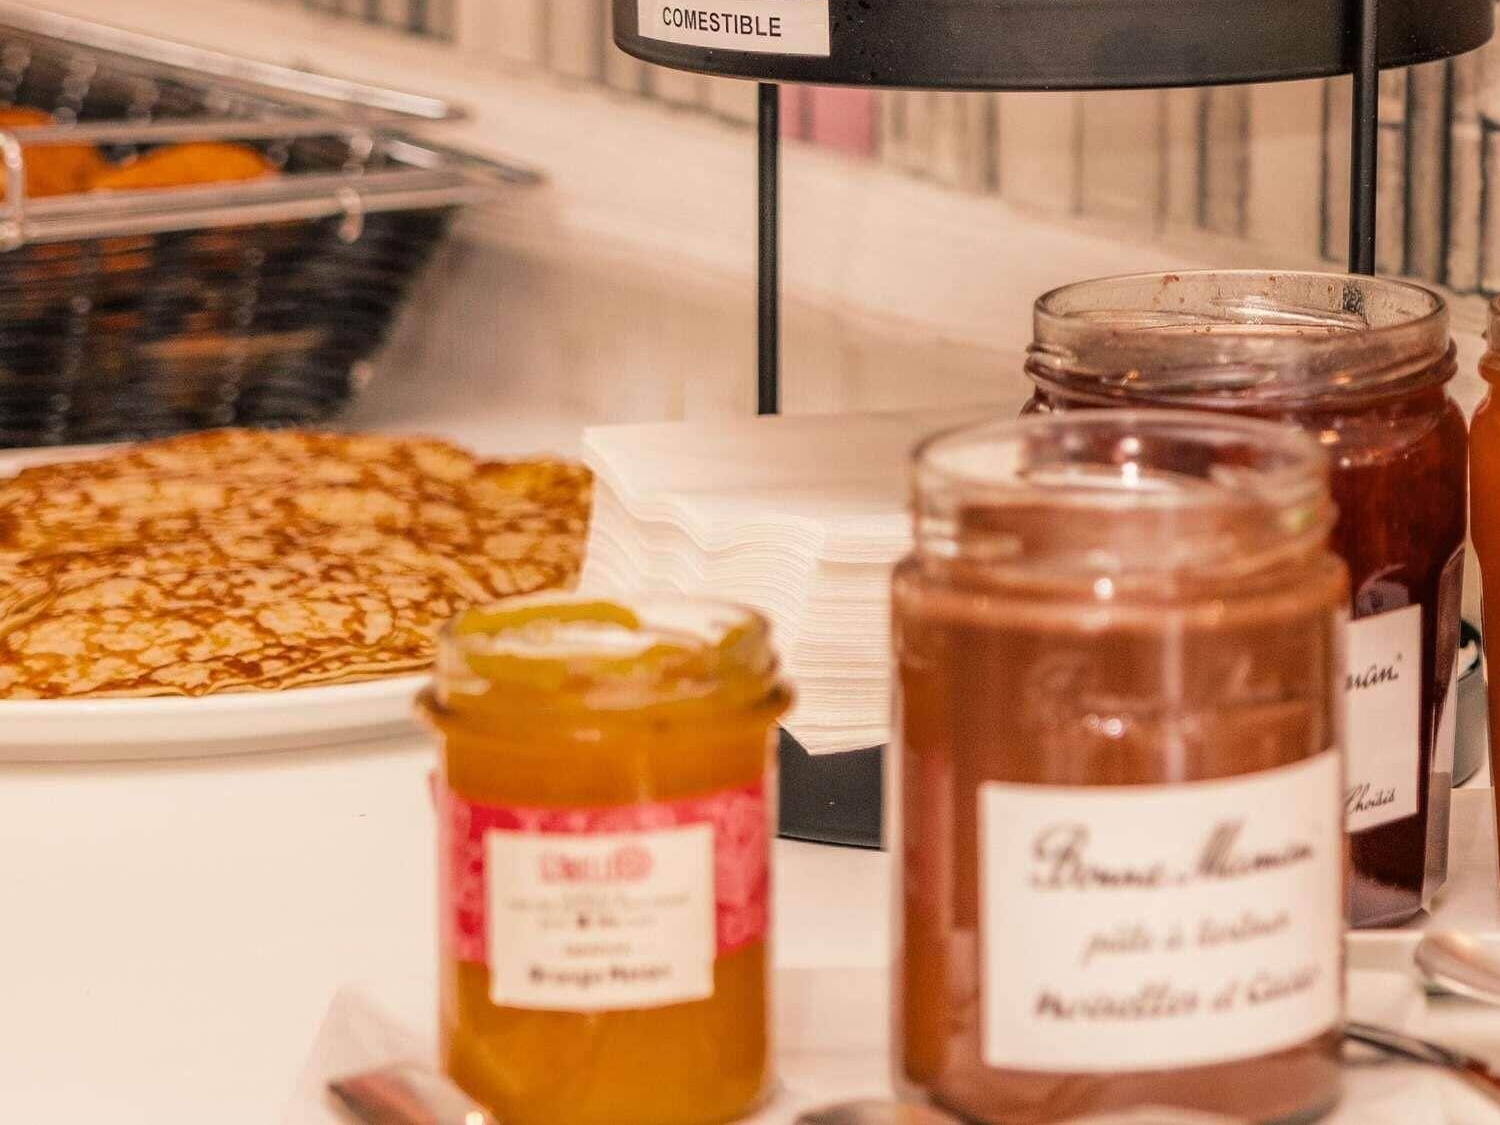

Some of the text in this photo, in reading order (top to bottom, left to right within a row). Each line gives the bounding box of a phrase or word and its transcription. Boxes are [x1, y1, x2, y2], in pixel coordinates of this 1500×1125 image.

[662, 6, 782, 38] COMESTIBLE
[1030, 817, 1314, 891] Bonne Maman
